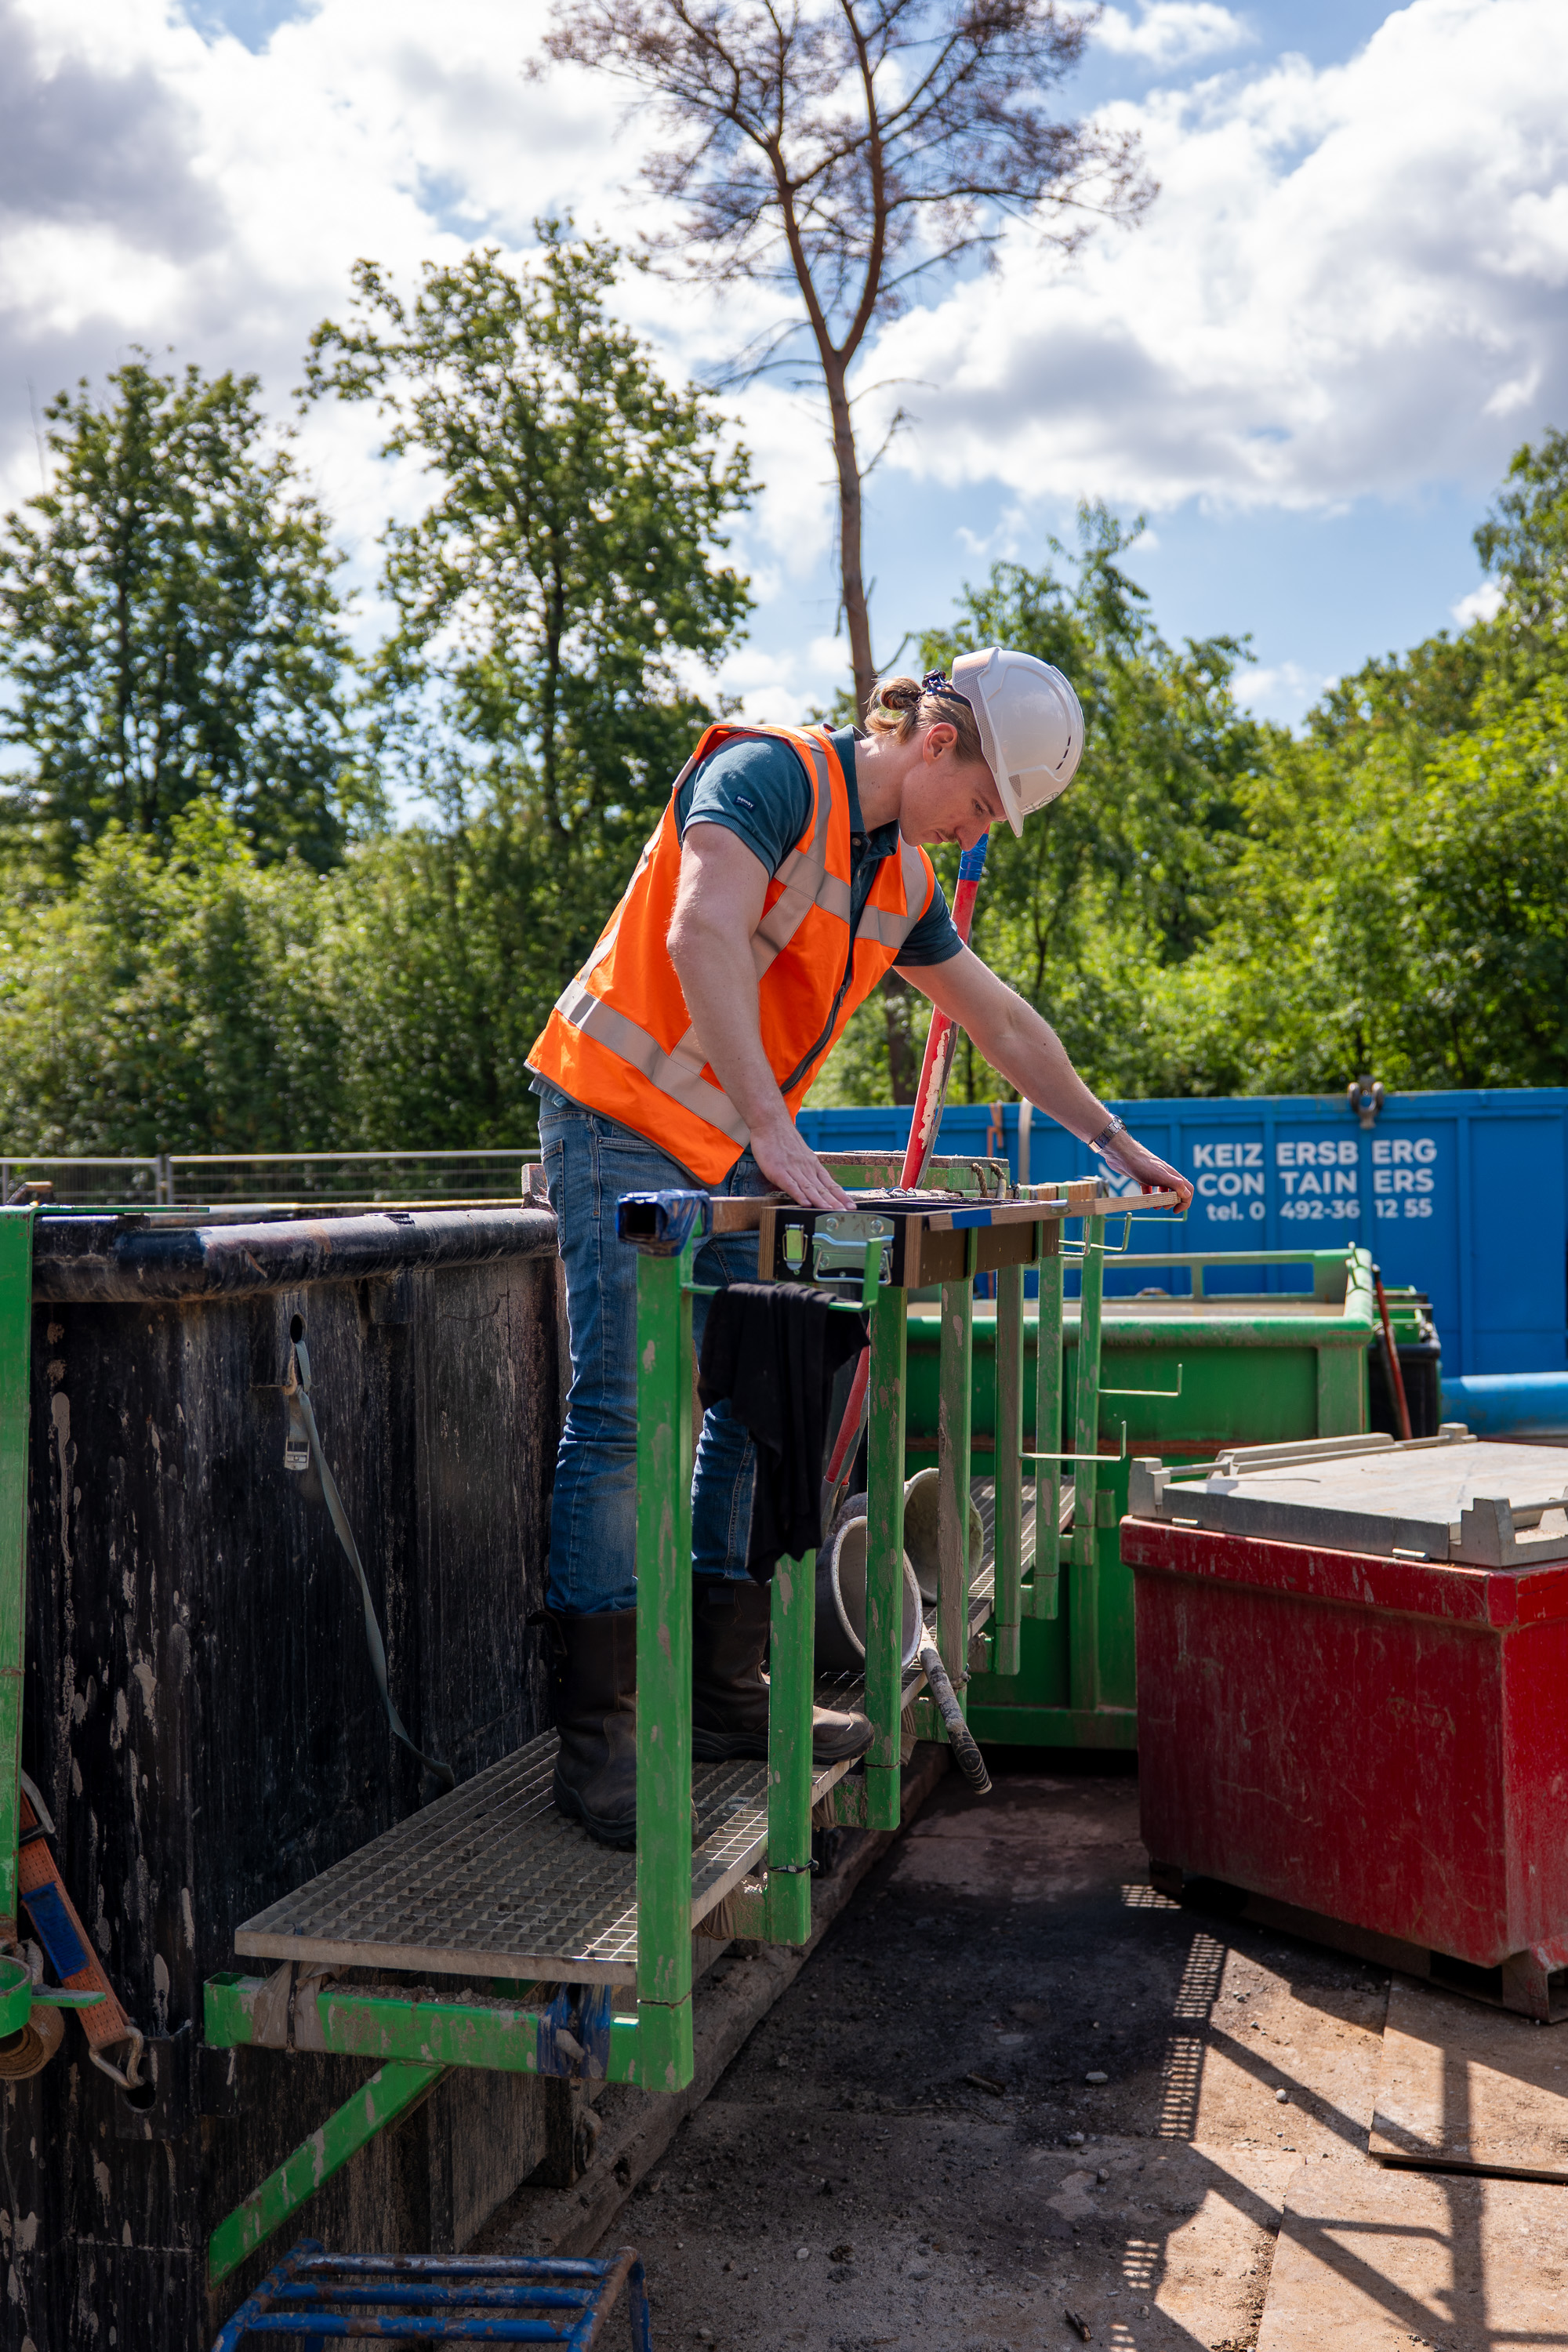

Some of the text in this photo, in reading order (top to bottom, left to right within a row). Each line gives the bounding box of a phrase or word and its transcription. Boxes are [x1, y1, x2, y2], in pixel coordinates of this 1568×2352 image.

[1192, 1138, 1438, 1168] KEIZ ERSB ERG
[1196, 1167, 1435, 1197] CON TAIN ERS
[1206, 1200, 1244, 1221] tel.
[1279, 1199, 1360, 1220] 492-36
[1374, 1199, 1399, 1218] 12
[1404, 1197, 1433, 1218] 55
